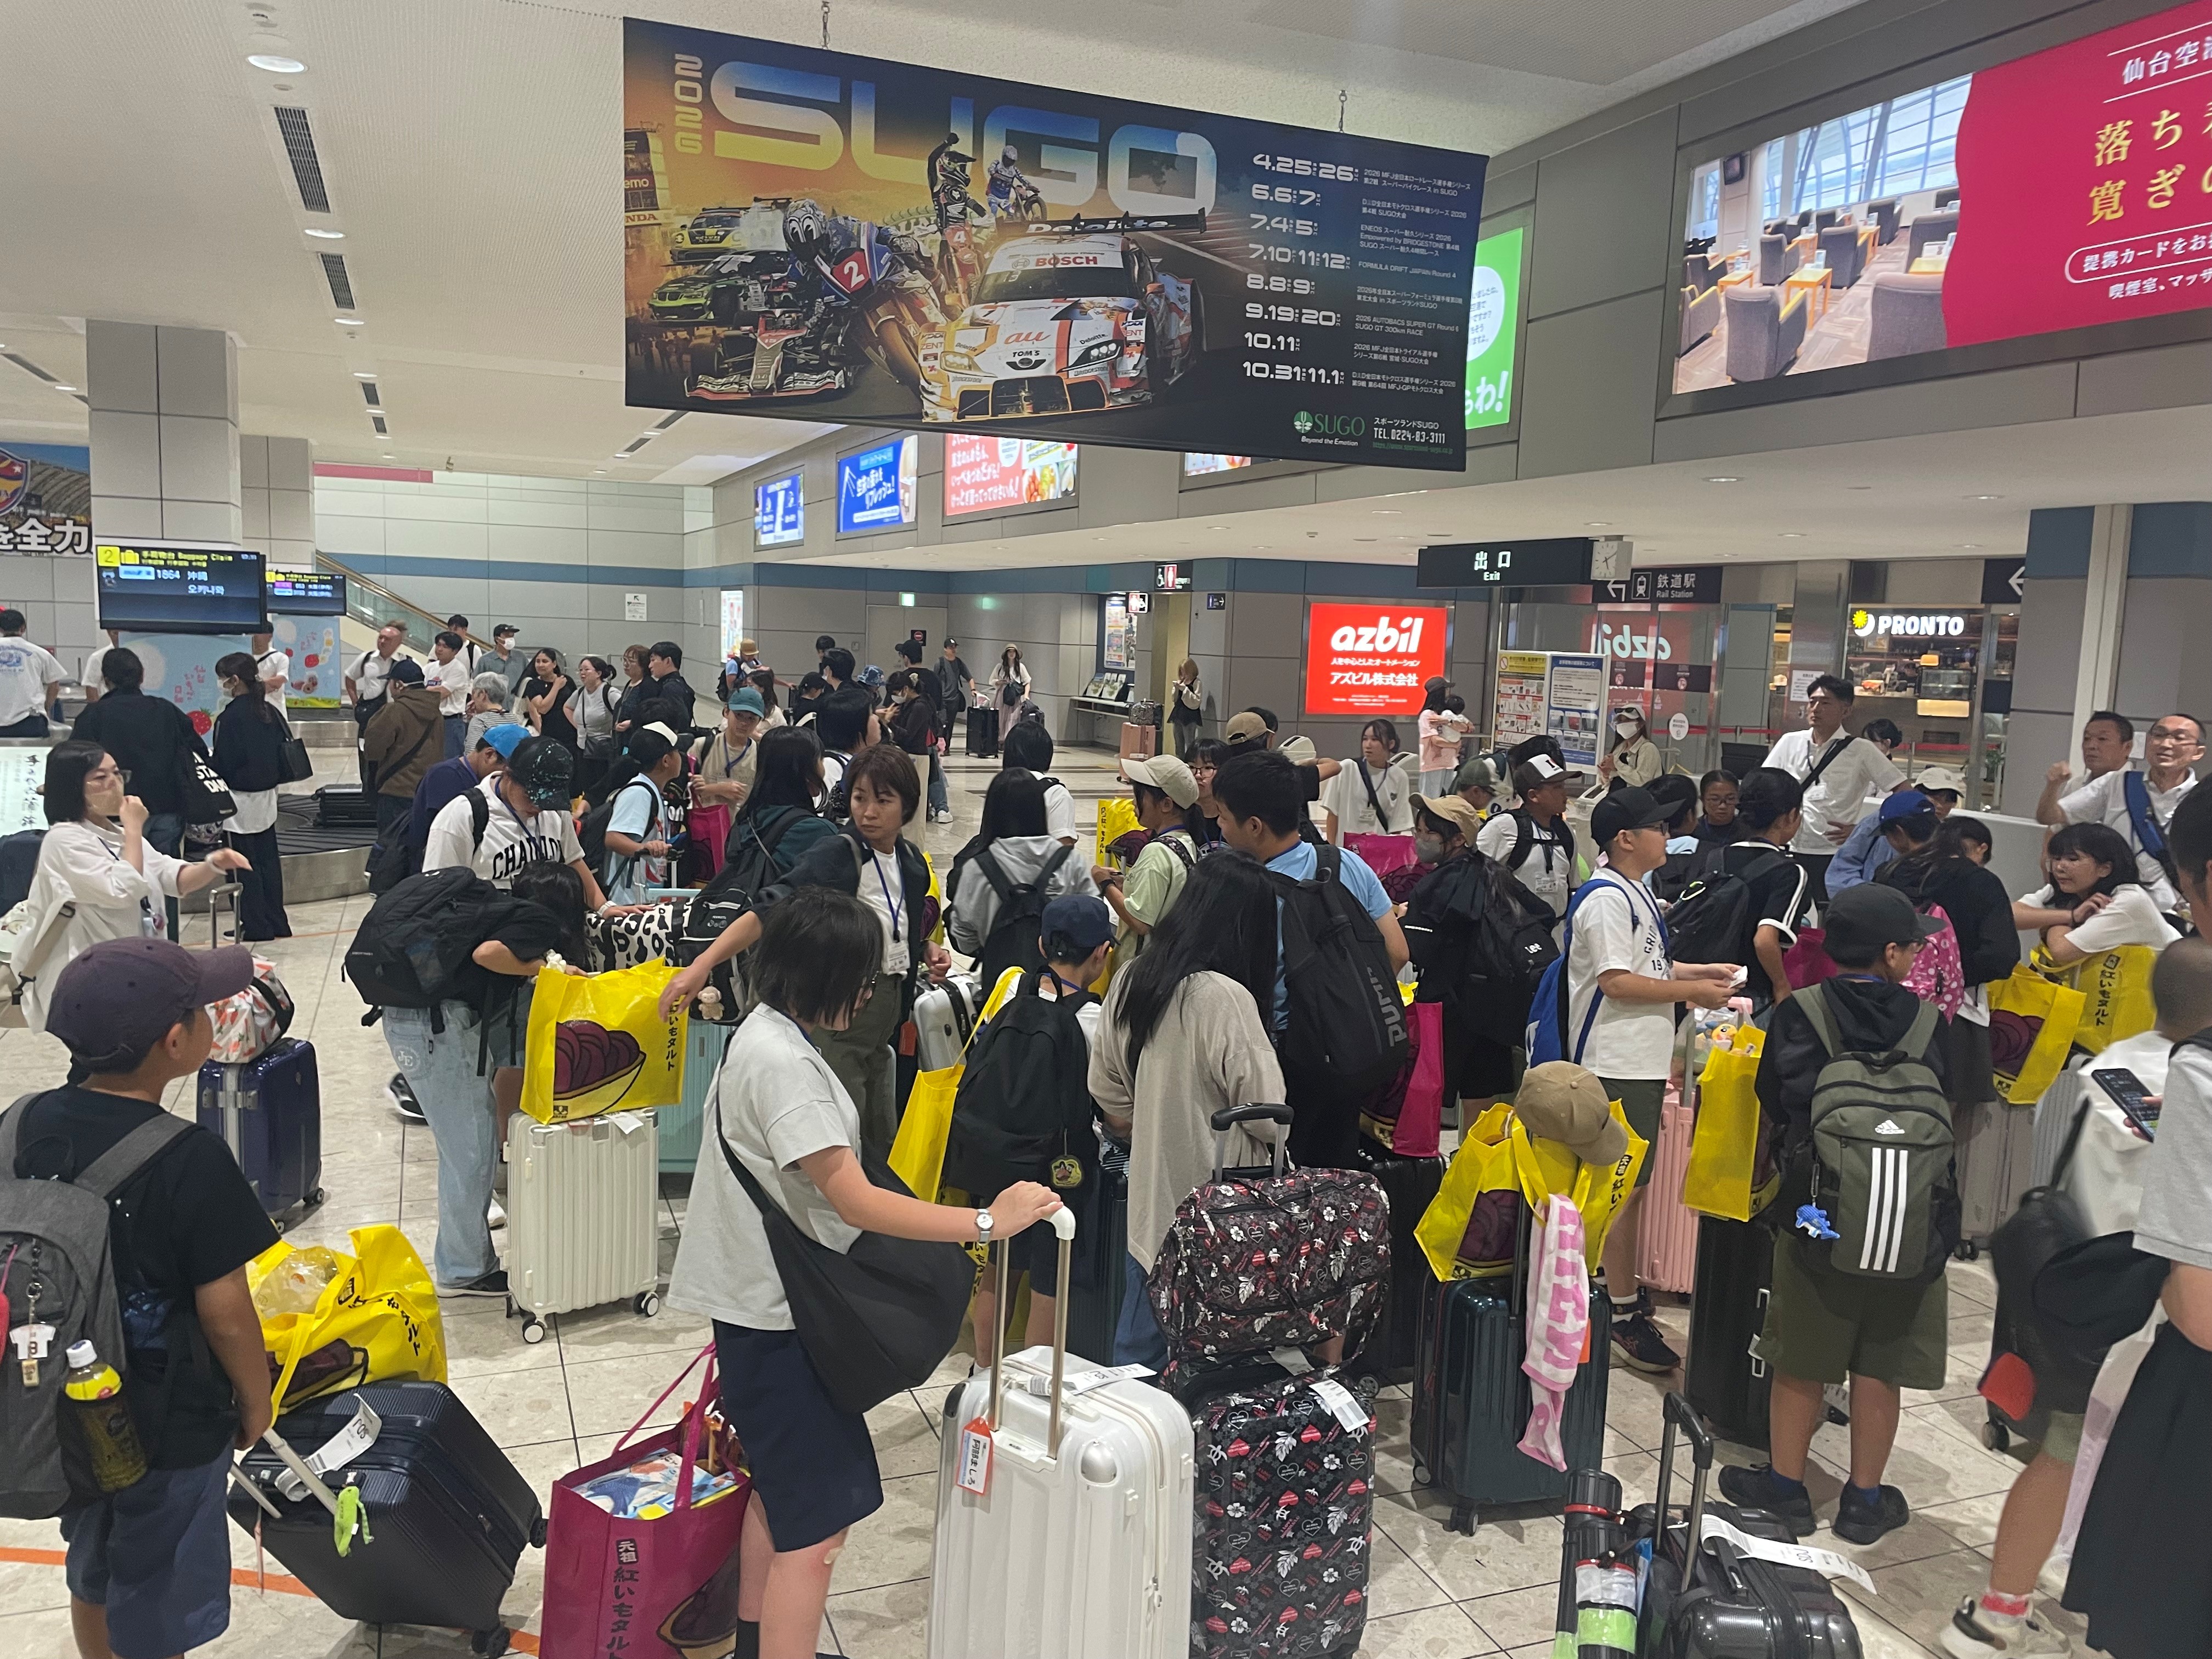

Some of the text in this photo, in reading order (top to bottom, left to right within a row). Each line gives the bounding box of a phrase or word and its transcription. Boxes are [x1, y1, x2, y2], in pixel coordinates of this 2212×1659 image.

[674, 53, 703, 155] 2026
[710, 61, 1217, 216] SUGO
[1364, 168, 1380, 177] 2026
[1382, 180, 1432, 193] スーパーバイクレース
[1361, 224, 1383, 233] ENEOS
[953, 230, 967, 243] 4
[1360, 233, 1393, 242] Empowered
[1403, 238, 1444, 249] BRIDGESTONE
[2083, 233, 2212, 273] 提携カードをお
[1035, 256, 1098, 267] BOSCH
[1358, 261, 1389, 270] FORMULA
[843, 261, 865, 289] 2
[1372, 317, 1405, 326] AUTOBACS
[1406, 320, 1426, 328] SUPER
[1437, 324, 1454, 332] Round
[1385, 326, 1406, 334] 300km
[1004, 331, 1051, 345] au
[1012, 349, 1040, 358] TOM'S
[1314, 414, 1365, 436] SUGO
[1374, 417, 1439, 430] スポーツランドSUGO
[1301, 436, 1323, 444] Beyond
[1334, 438, 1358, 447] Emotion
[104, 549, 114, 563] 2
[1474, 550, 1511, 571] 出口
[1483, 571, 1500, 582] Exit
[1657, 573, 1696, 589] 鉄道駅
[1877, 615, 1965, 636] PRONTO
[1330, 616, 1424, 653] azbil
[1330, 672, 1419, 687] アズビル株式会社
[618, 1540, 637, 1563] 元祖
